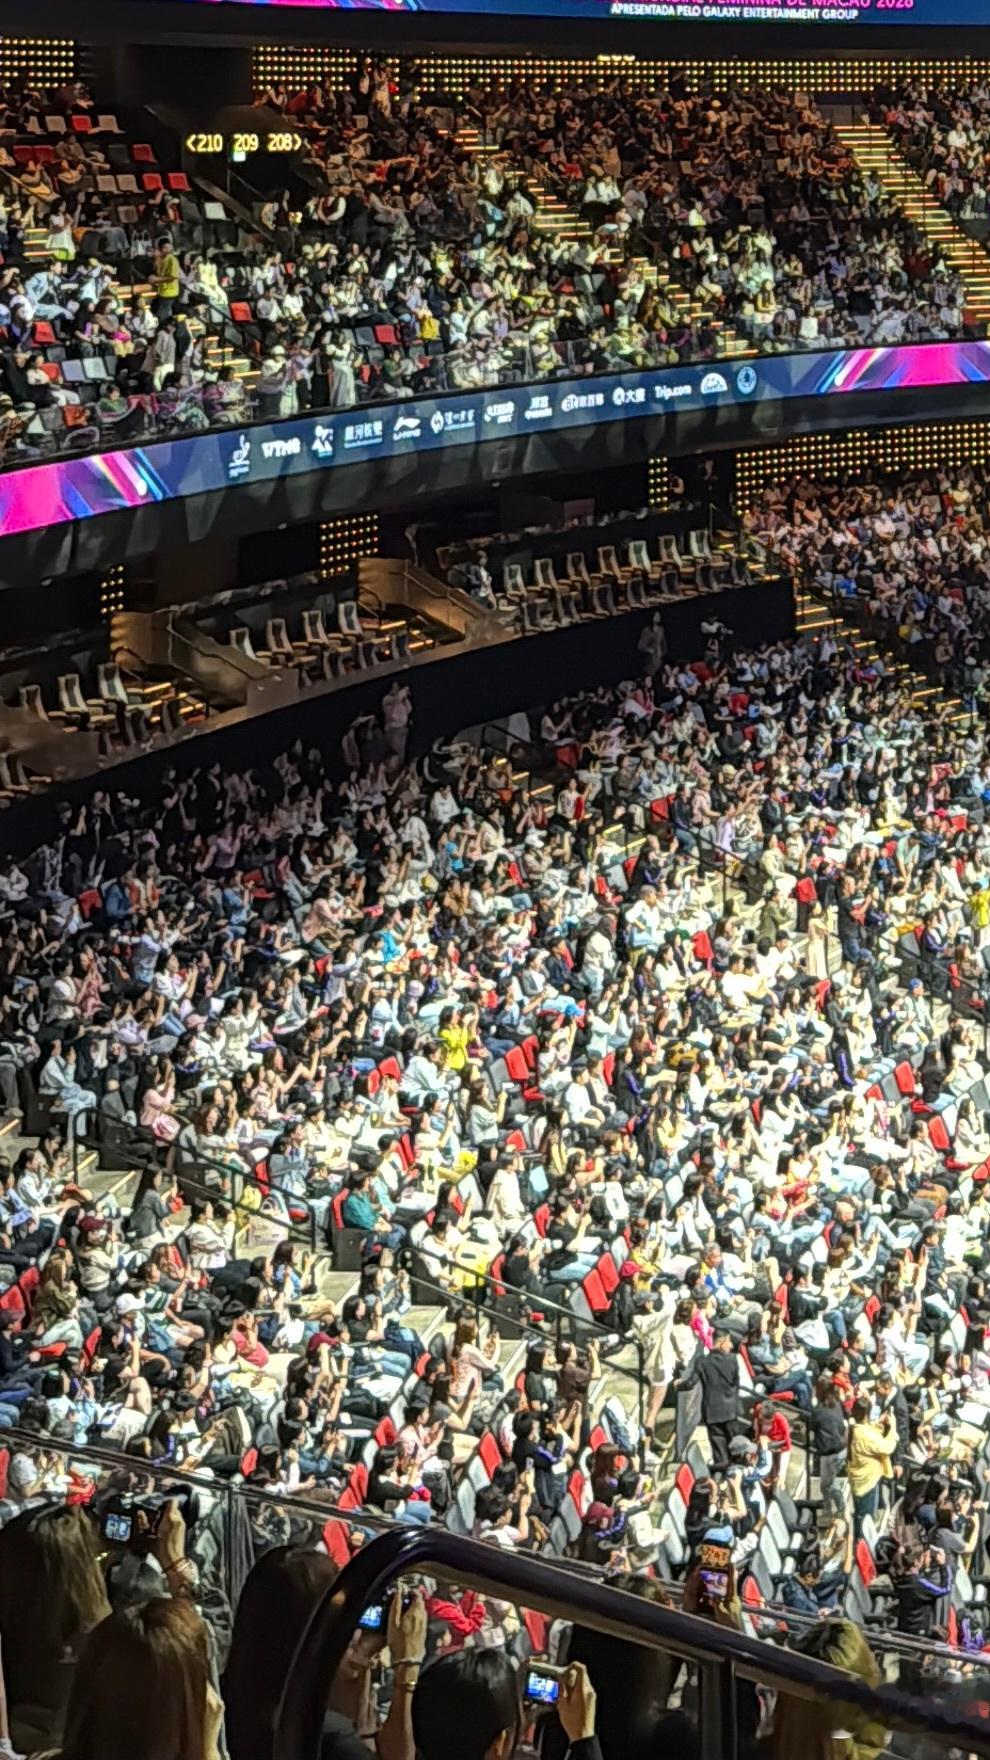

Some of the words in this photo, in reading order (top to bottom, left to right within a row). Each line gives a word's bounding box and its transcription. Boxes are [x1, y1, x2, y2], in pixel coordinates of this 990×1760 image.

[611, 3, 675, 16] APRESENTADA
[677, 4, 700, 17] PELO
[703, 6, 740, 18] GALAXY
[743, 7, 821, 19] ENTERTAINMENT
[822, 8, 859, 20] GROUP
[197, 133, 223, 152] 210
[233, 133, 259, 152] 209
[267, 132, 293, 151] 208
[654, 384, 692, 400] Trip.com
